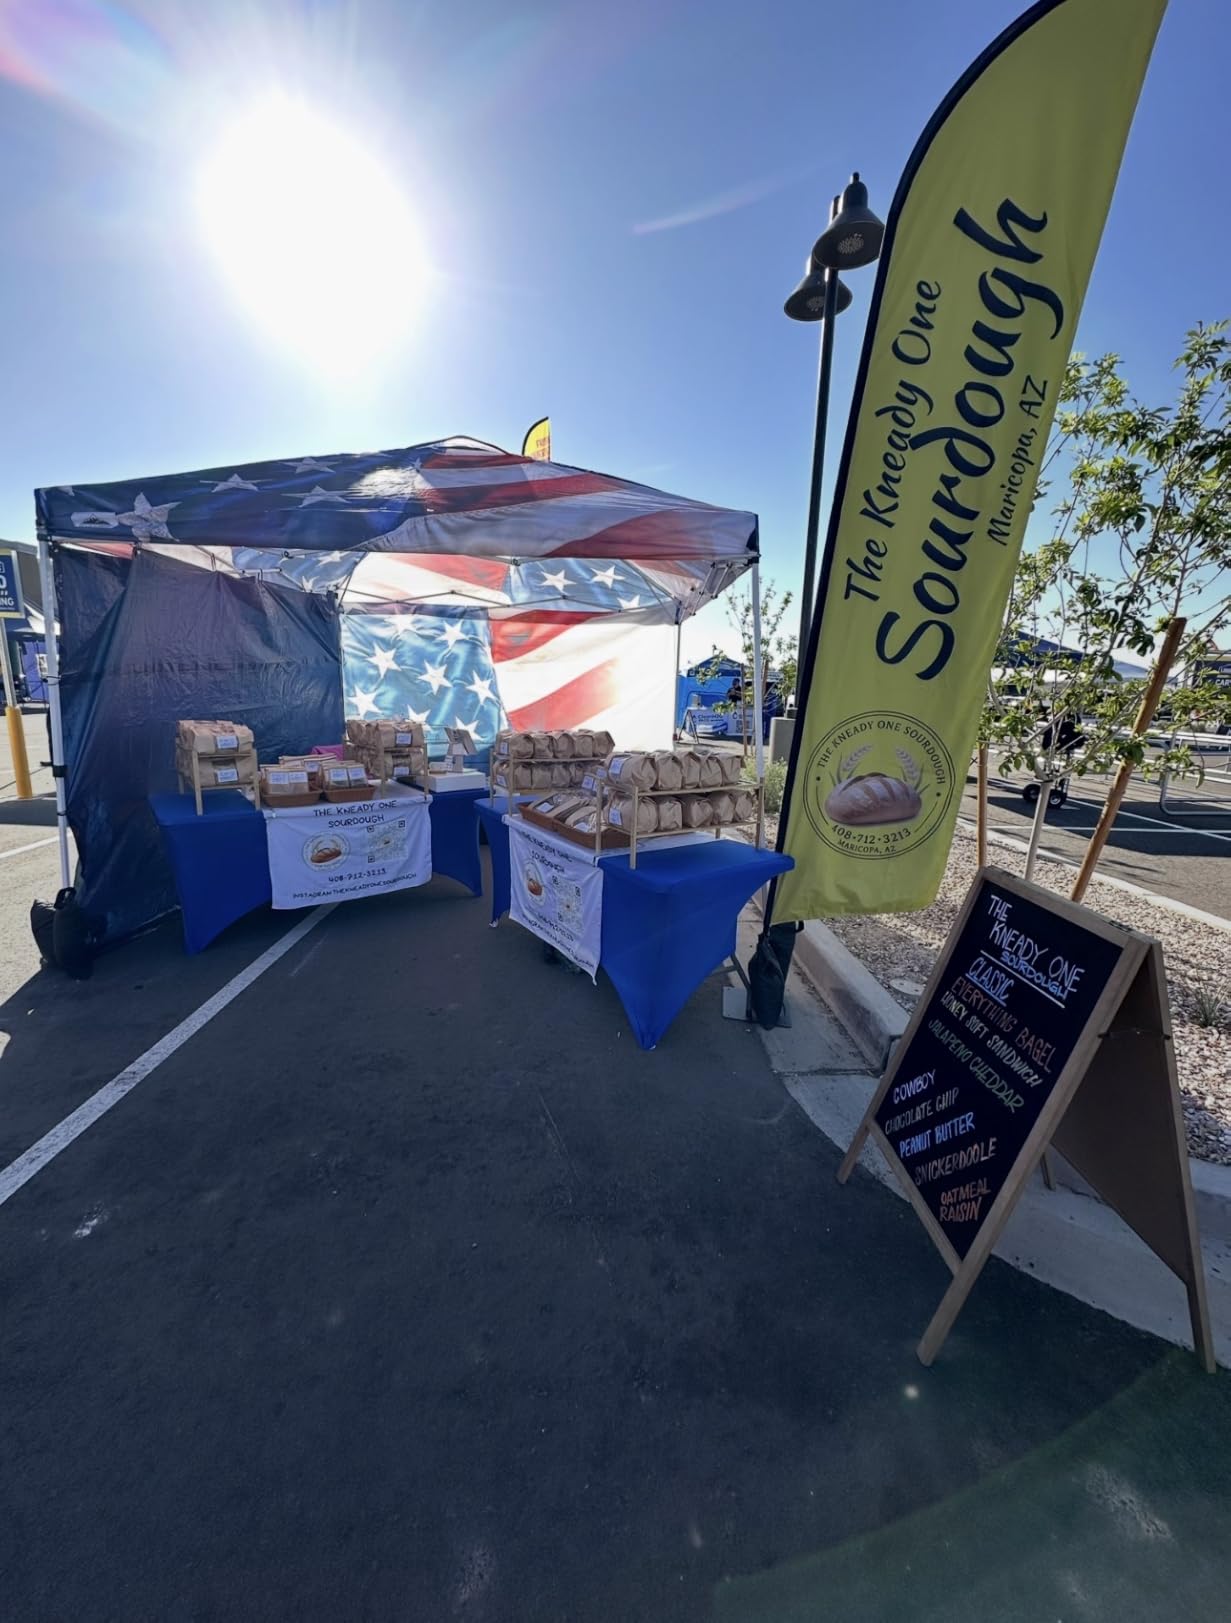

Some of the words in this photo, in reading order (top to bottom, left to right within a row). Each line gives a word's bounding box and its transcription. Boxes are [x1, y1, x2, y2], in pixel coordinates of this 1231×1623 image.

[891, 279, 942, 366] One
[859, 382, 934, 528] Kneady
[875, 197, 1064, 681] Sourdough
[987, 427, 1038, 547] Maricopa,
[1021, 374, 1049, 419] AZ
[844, 538, 888, 602] The
[818, 747, 833, 768] THE
[833, 720, 874, 749] KNEADY
[877, 720, 902, 732] ONE
[903, 726, 946, 785] SOURDOUGH
[313, 809, 332, 817] THE
[337, 802, 376, 816] KNEADY
[379, 800, 397, 809] ONE
[328, 814, 385, 828] SOURDOUGH
[837, 839, 882, 854] MARICOPA,
[884, 845, 897, 853] AZ
[987, 894, 1013, 921] THE
[968, 957, 1015, 1001] CLASSIC
[989, 921, 1049, 966] KNEADY
[1048, 956, 1086, 993] ONE
[1000, 950, 1069, 1000] SOURDOUGH
[951, 976, 1018, 1032] EVERYTHING
[1015, 1026, 1056, 1073] BAGEL
[965, 1015, 989, 1039] SOFT
[986, 1035, 1043, 1088] SANDWICH
[893, 1069, 936, 1104] COWBOY
[968, 1056, 1025, 1113] CHEDDAR
[885, 1099, 934, 1136] CHOCOLATE
[935, 1086, 960, 1113] CHIP
[900, 1129, 932, 1159] PEANUT
[935, 1111, 976, 1145] BUTTER
[939, 1196, 983, 1223] RAISIN
[940, 1177, 992, 1206] OATMEAL
